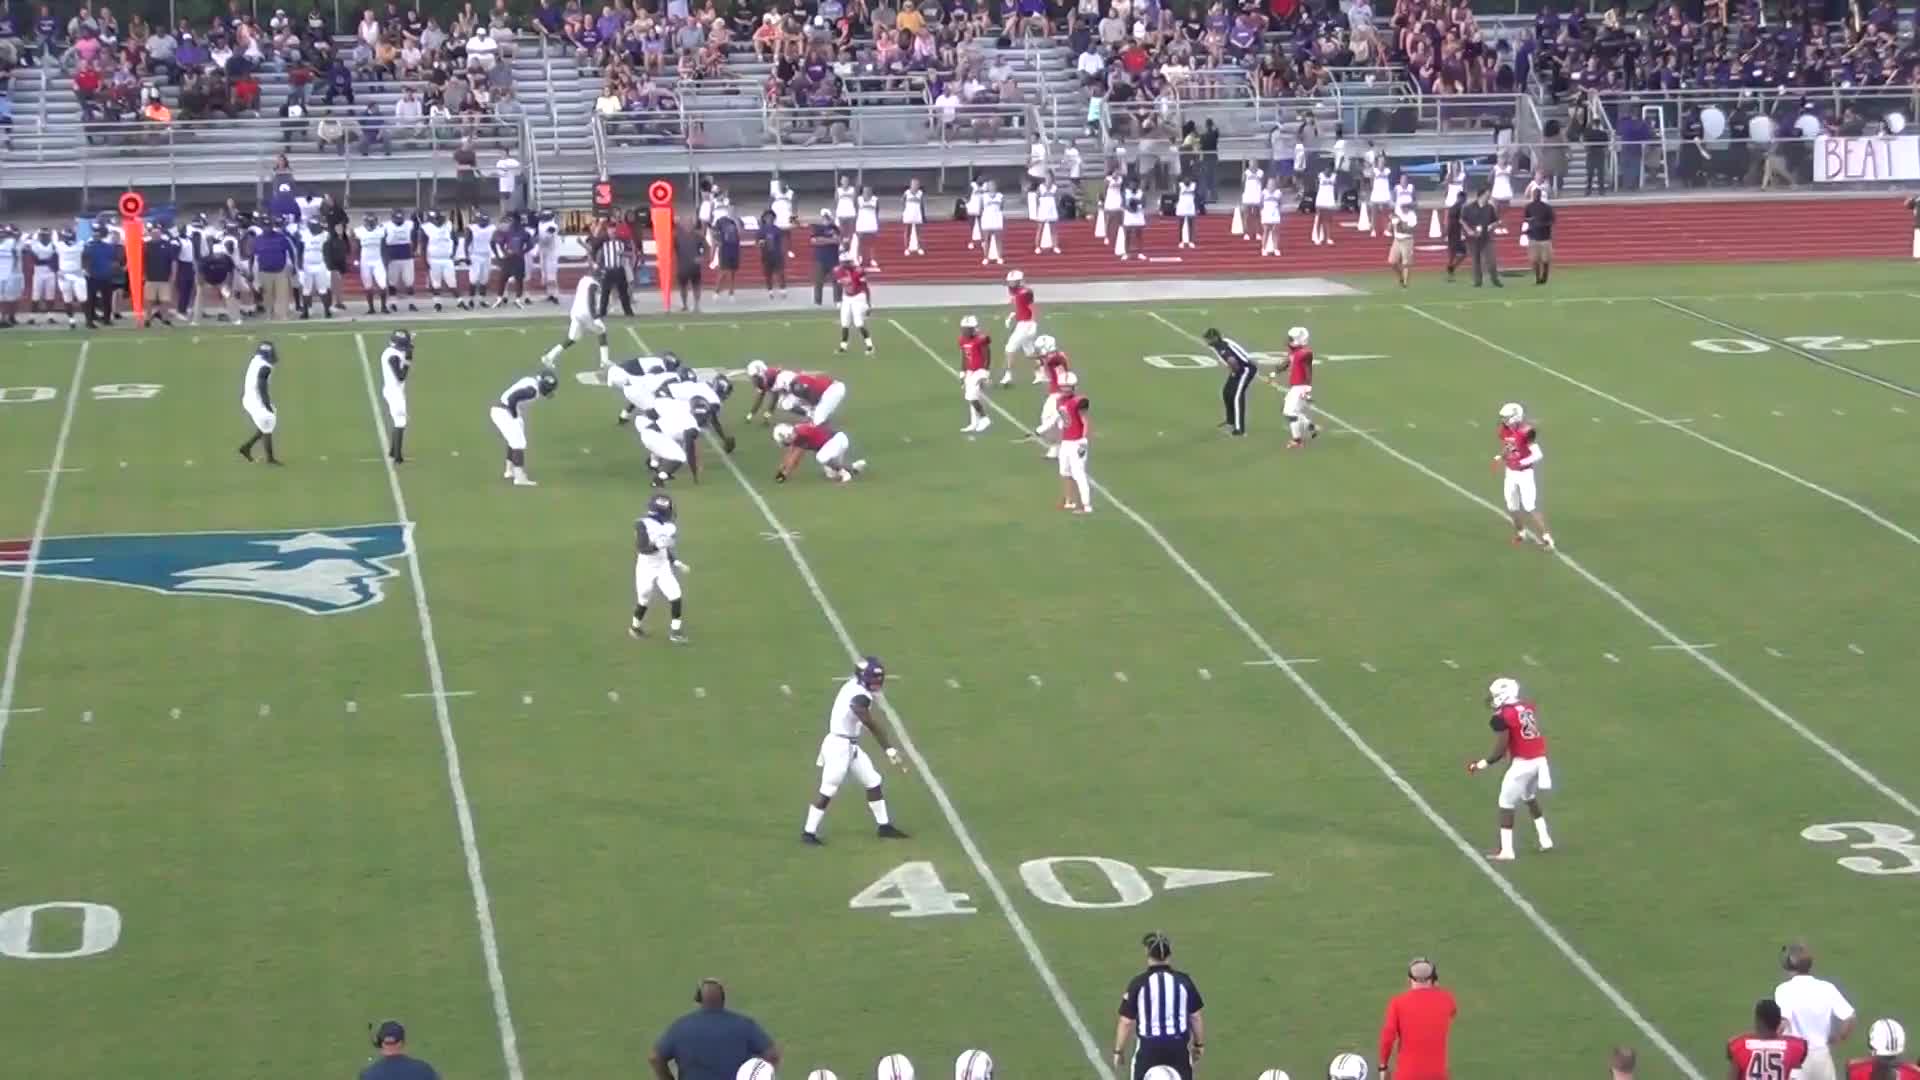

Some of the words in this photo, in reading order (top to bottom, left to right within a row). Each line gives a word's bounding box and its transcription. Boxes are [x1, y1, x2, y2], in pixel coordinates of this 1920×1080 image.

[1824, 138, 1893, 178] BEAT
[595, 183, 611, 204] 3
[849, 856, 1153, 917] 40
[1748, 1049, 1784, 1080] 45
